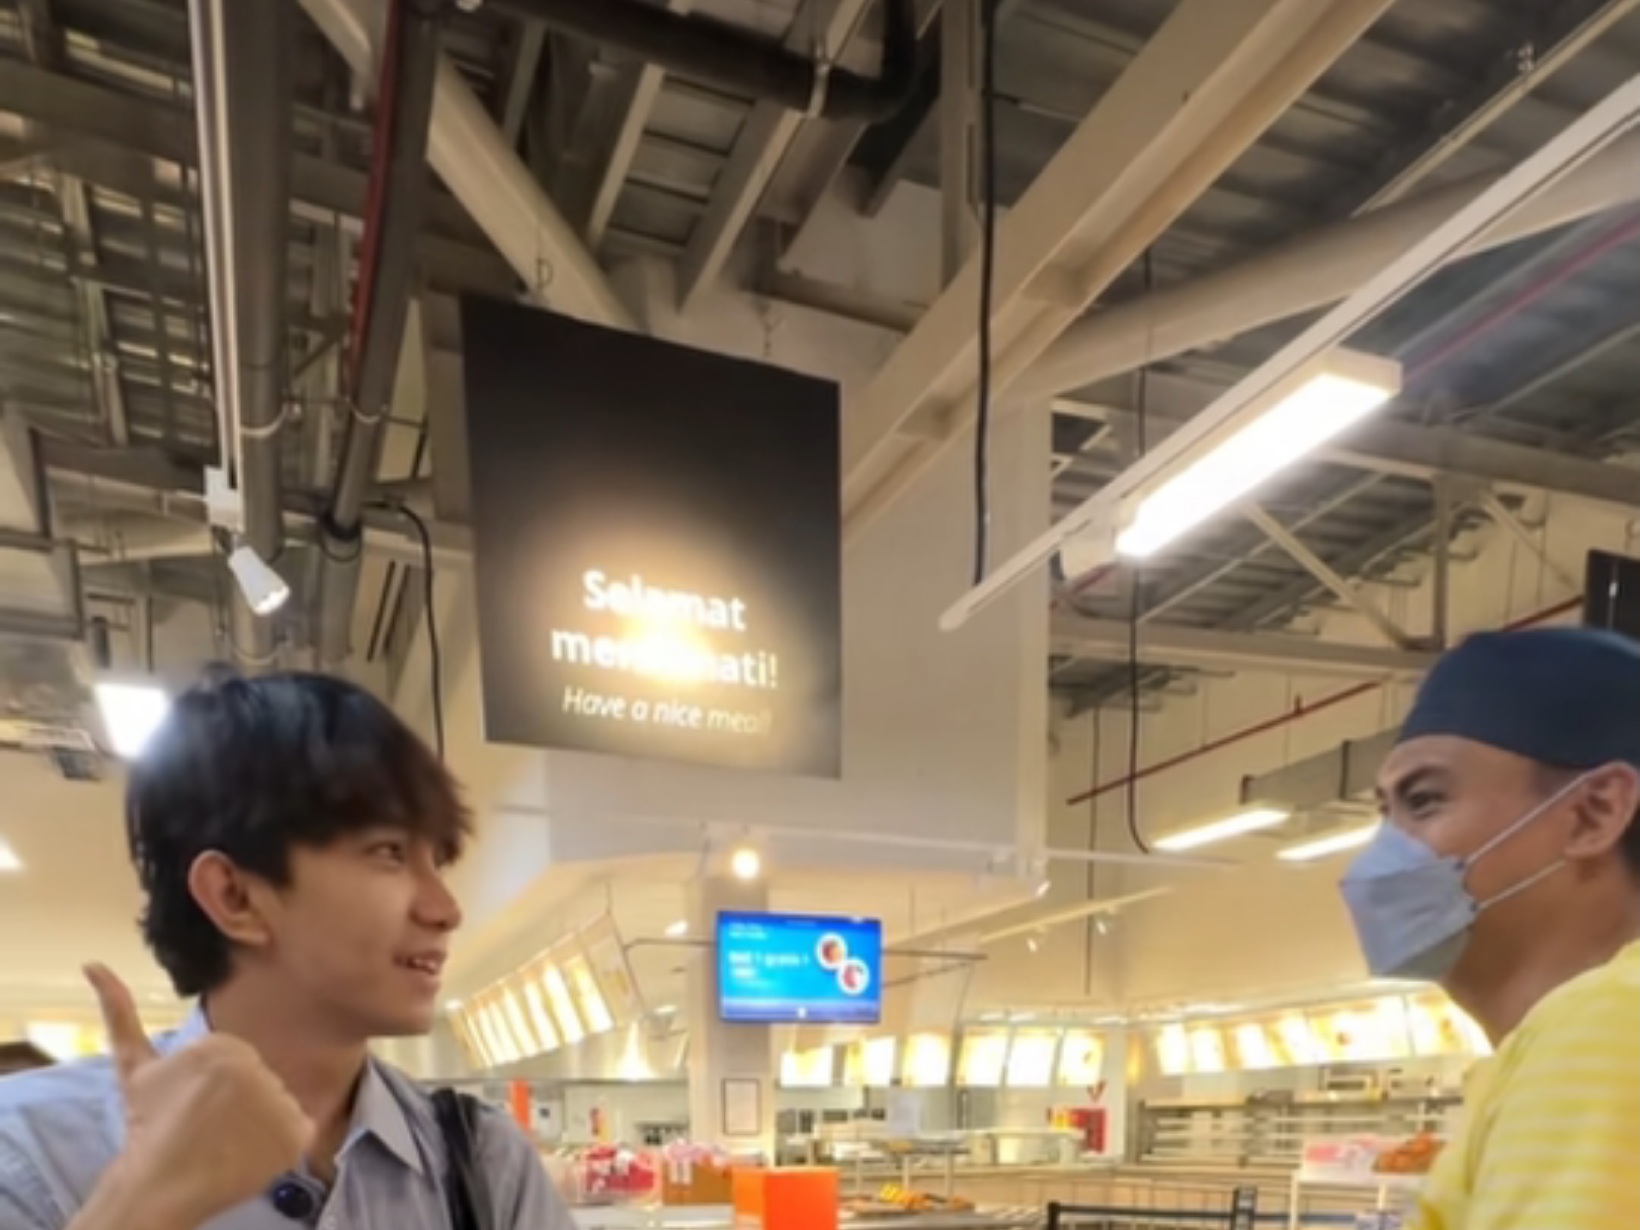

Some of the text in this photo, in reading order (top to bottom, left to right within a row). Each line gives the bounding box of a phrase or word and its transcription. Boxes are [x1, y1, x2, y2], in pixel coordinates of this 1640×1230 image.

[551, 629, 778, 688] meati!
[562, 686, 627, 718] Have
[631, 698, 648, 721] a
[652, 699, 702, 728] nice
